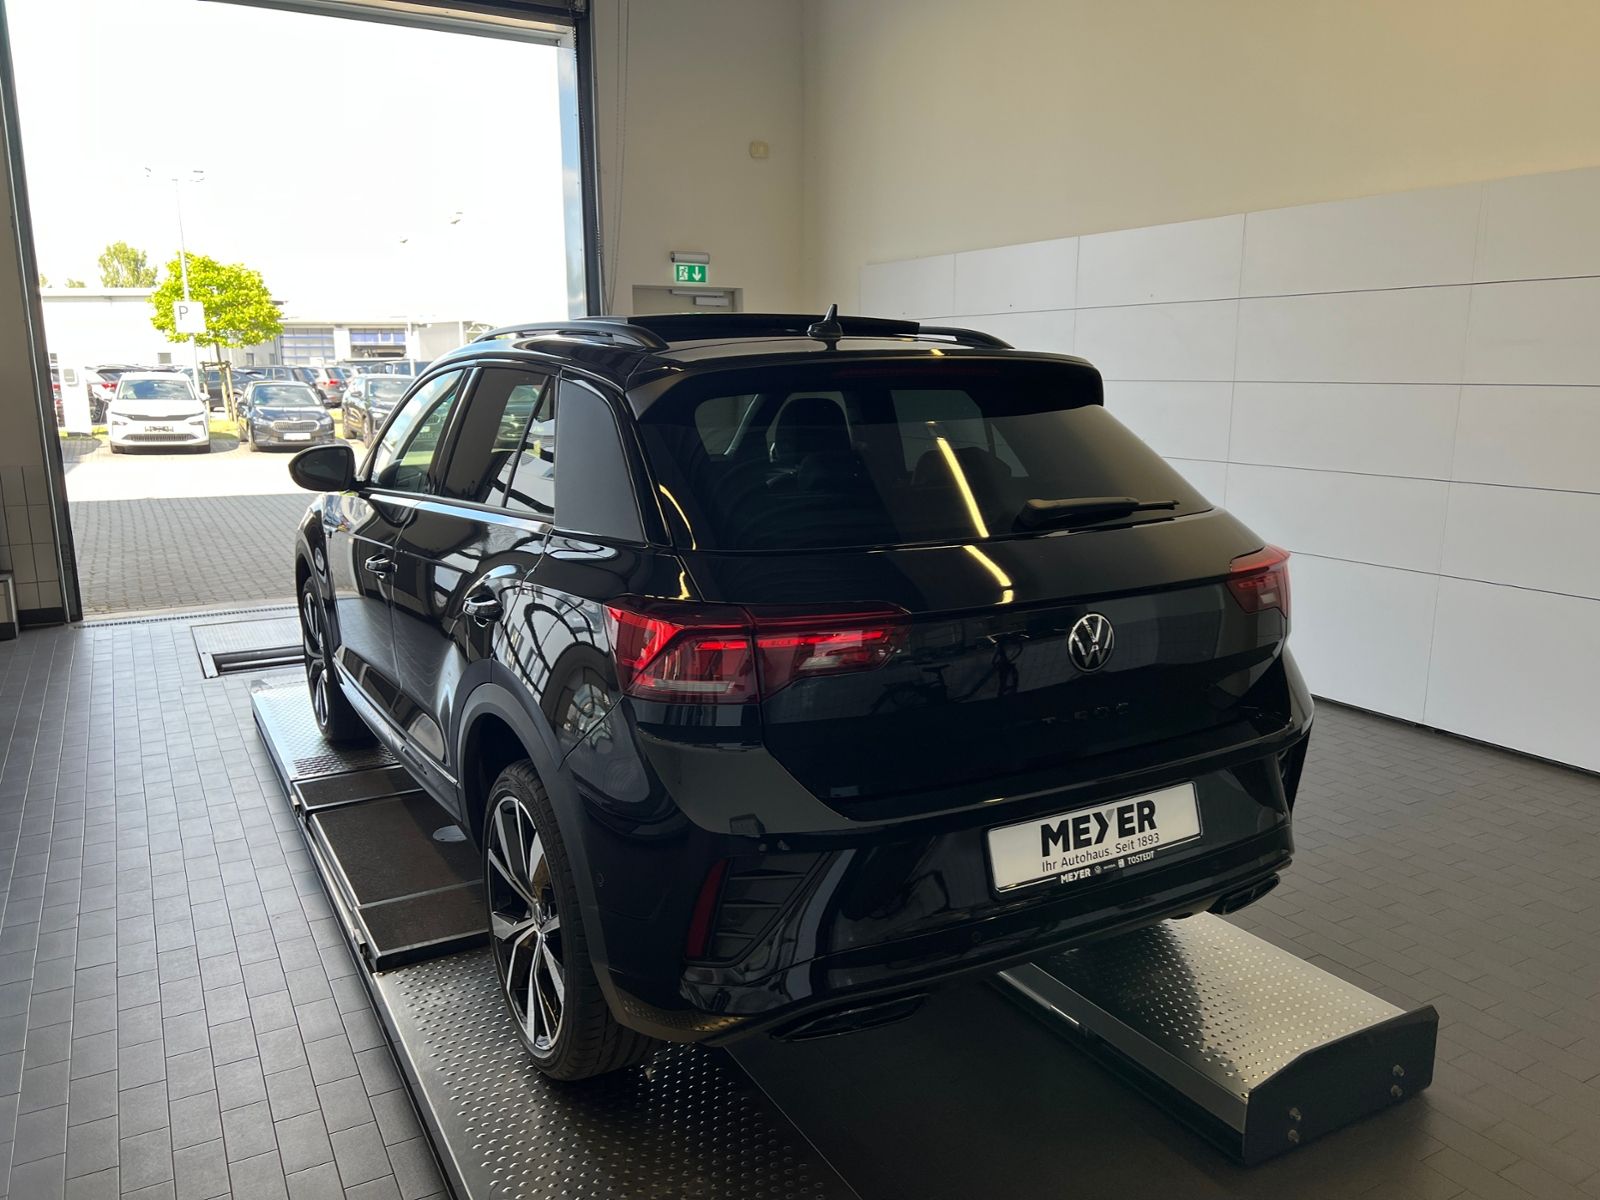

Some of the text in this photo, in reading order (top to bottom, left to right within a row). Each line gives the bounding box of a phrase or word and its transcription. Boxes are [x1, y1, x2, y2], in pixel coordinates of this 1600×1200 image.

[178, 305, 189, 321] P
[1040, 800, 1157, 858] MEYER
[1042, 861, 1057, 873] Ihr
[1060, 848, 1113, 869] Autohaus.
[1115, 839, 1136, 854] Seit
[1138, 832, 1160, 848] 1893
[1060, 850, 1156, 885] MEYER TOSTEDT
